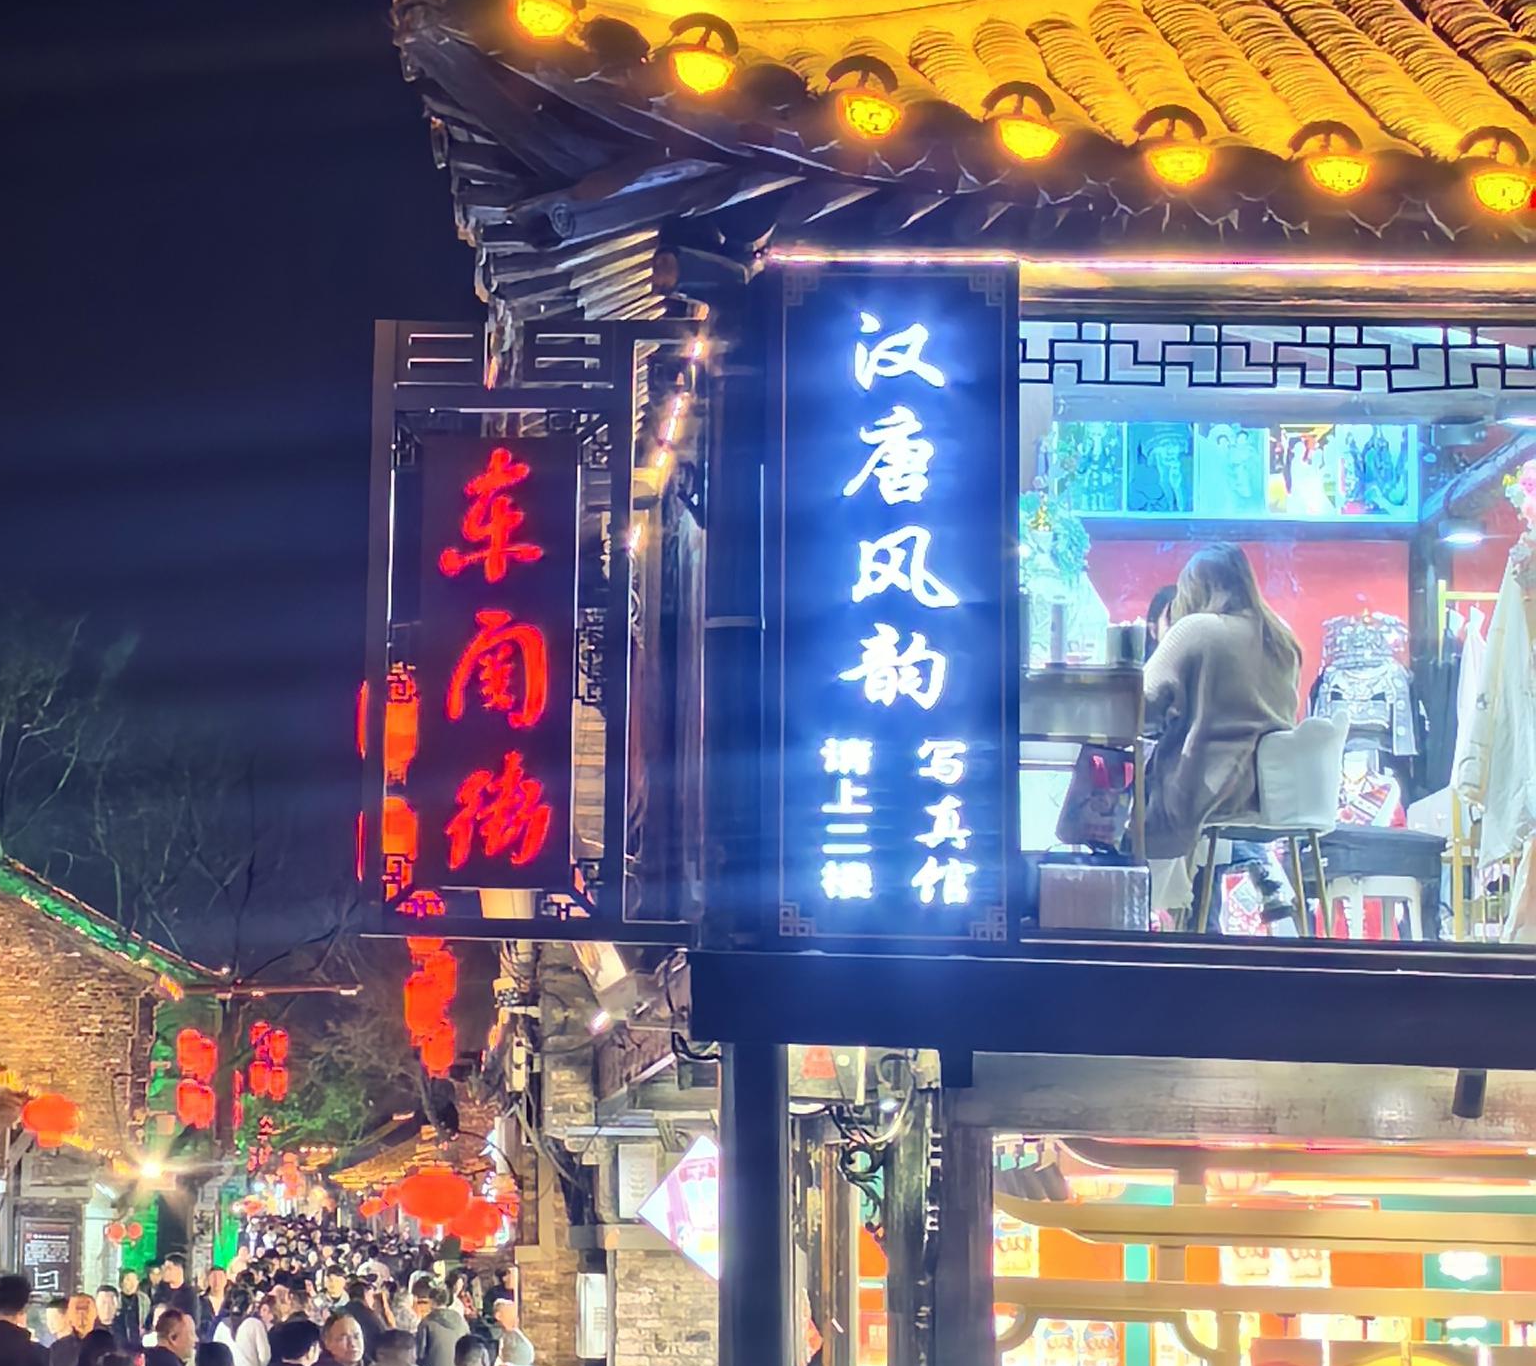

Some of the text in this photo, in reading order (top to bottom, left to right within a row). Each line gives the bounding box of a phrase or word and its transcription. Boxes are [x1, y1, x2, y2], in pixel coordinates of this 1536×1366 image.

[839, 311, 961, 712] 汉唐风韵
[911, 739, 978, 905] 写真馆
